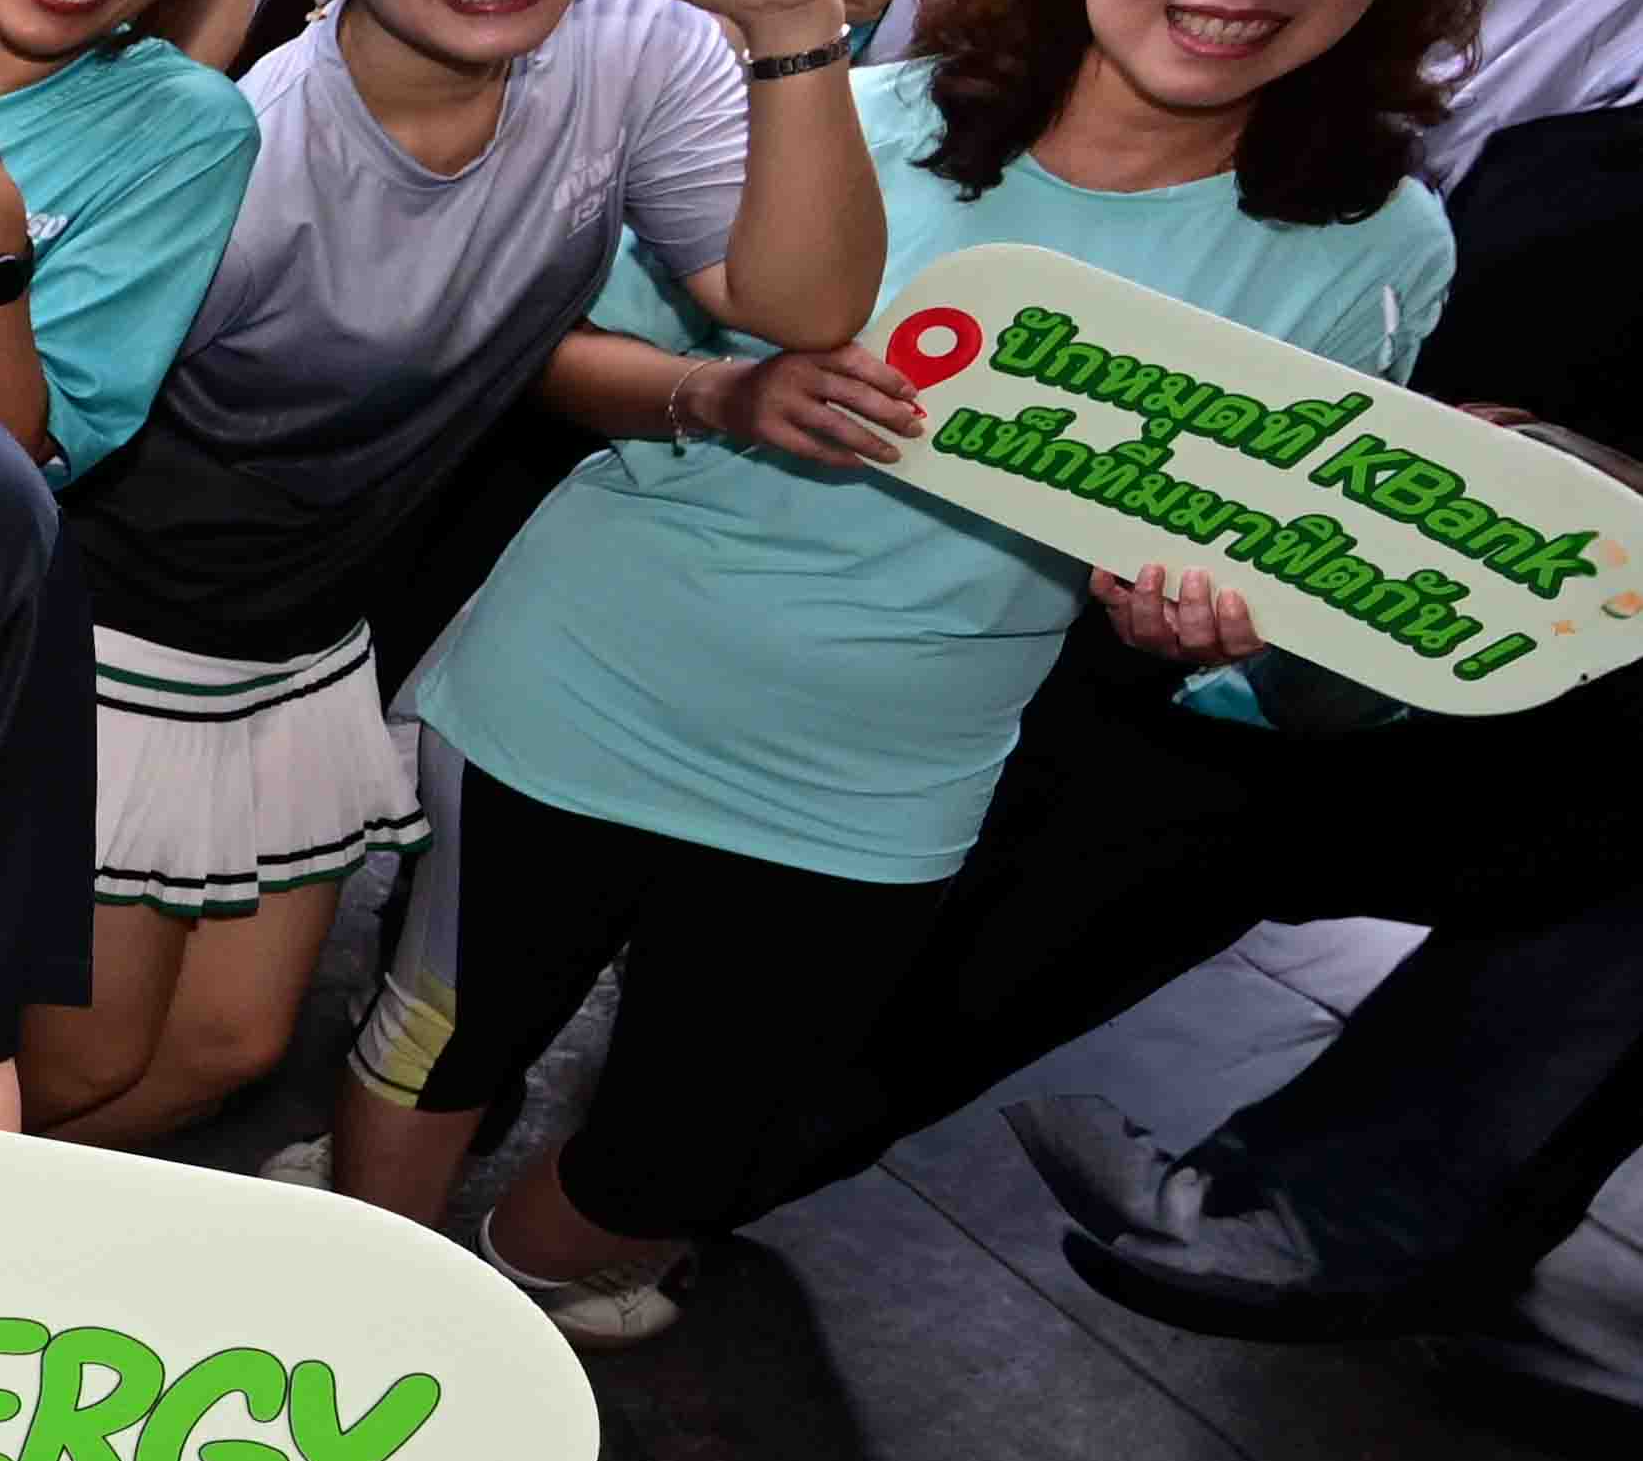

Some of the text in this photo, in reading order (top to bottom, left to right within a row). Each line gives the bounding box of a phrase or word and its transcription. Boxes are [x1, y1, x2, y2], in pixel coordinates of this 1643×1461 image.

[988, 306, 1600, 598] ปักหมุดที่ KBank
